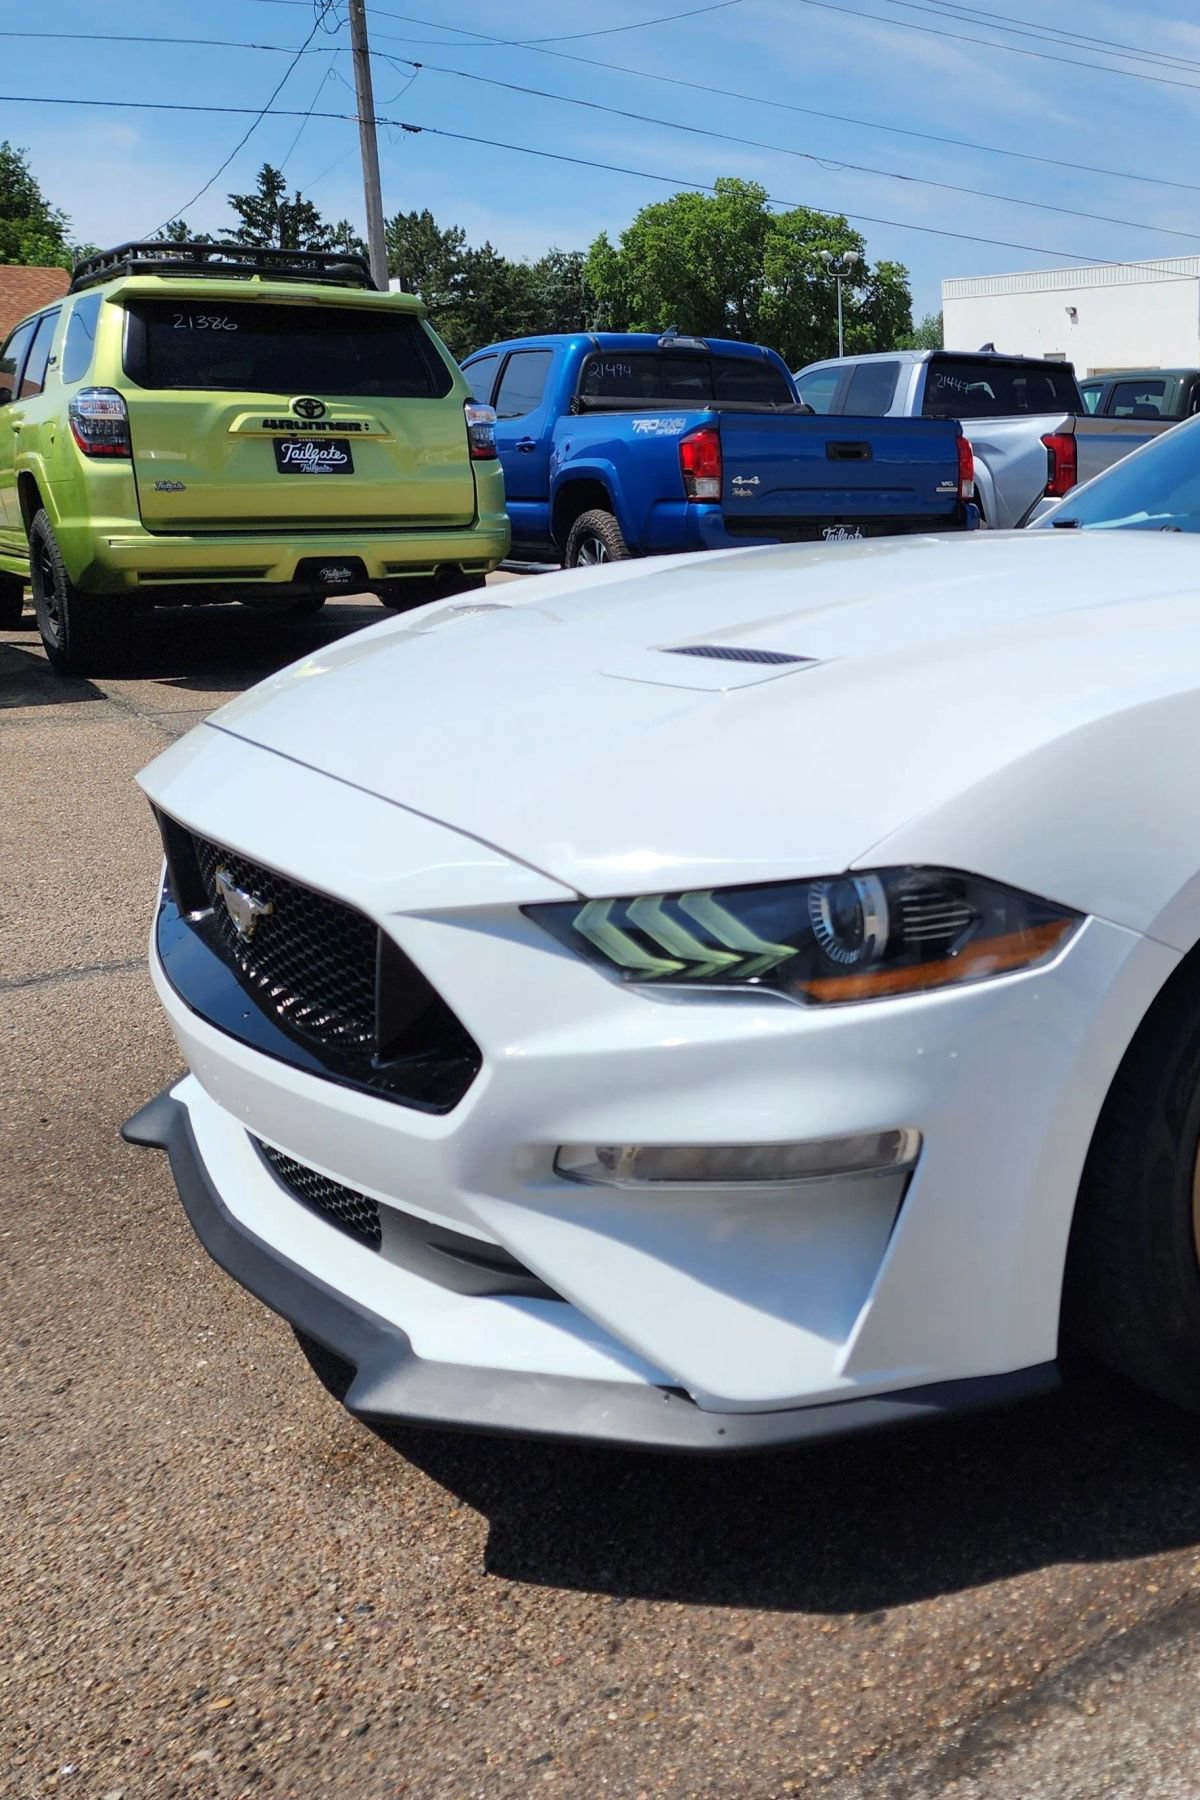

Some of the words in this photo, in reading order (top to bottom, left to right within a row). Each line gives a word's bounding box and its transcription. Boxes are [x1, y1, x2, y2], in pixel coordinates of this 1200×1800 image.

[173, 313, 239, 331] 21386
[588, 361, 632, 378] 21494
[262, 419, 362, 431] 4RUNNER
[631, 419, 660, 433] TRD
[281, 443, 348, 465] Tailgate
